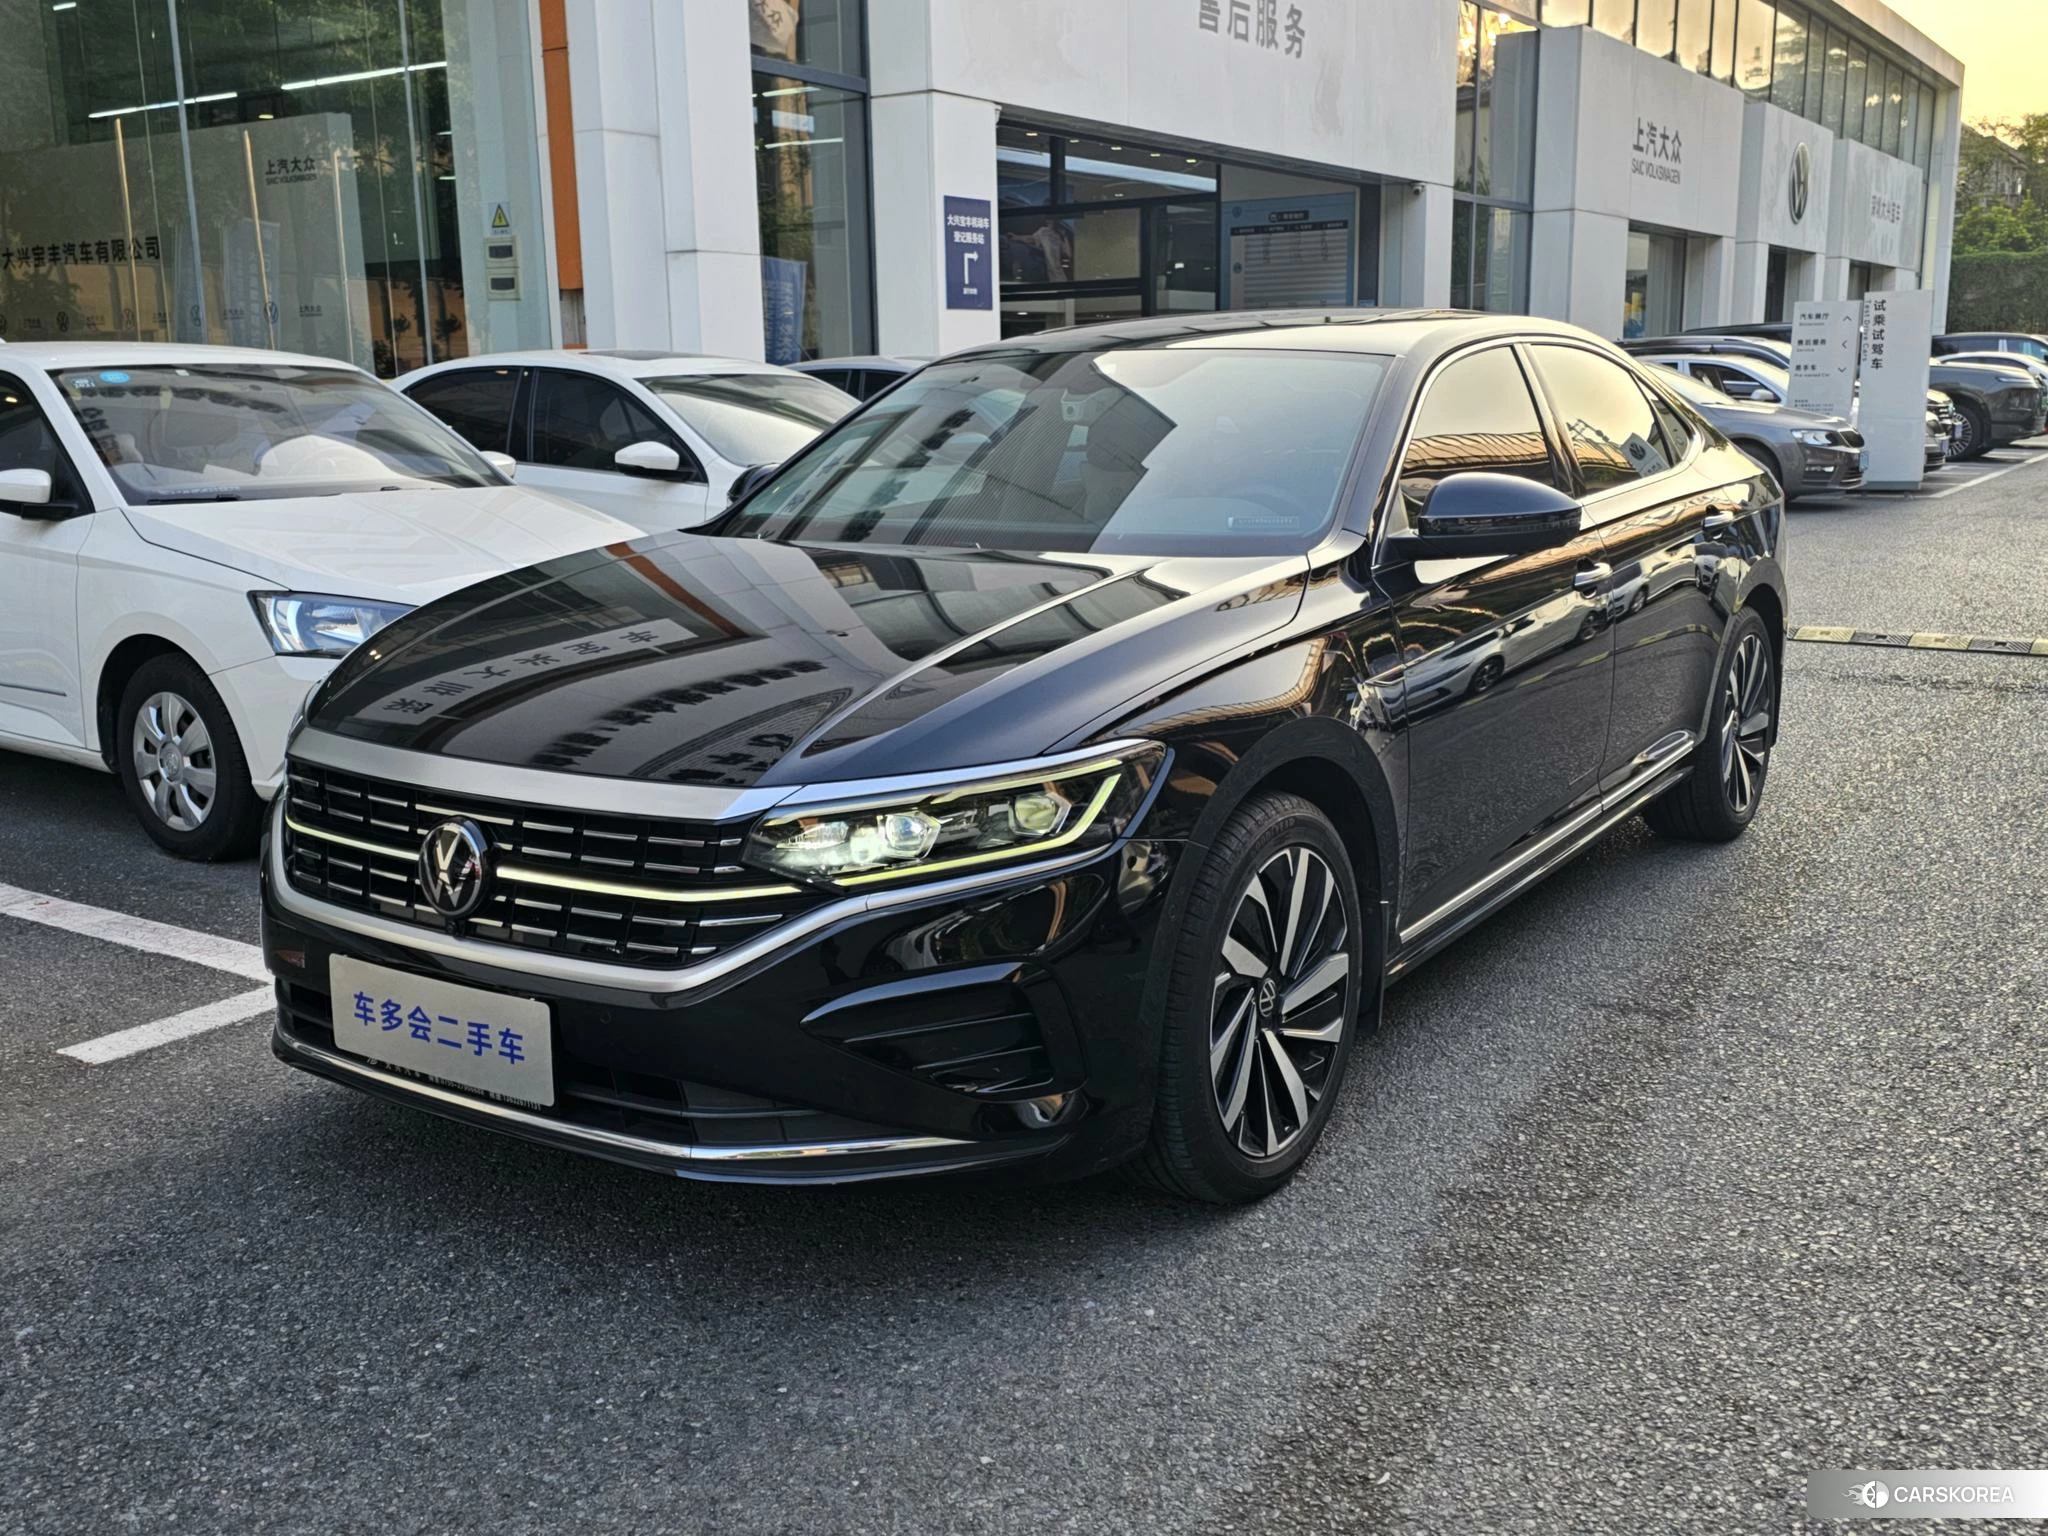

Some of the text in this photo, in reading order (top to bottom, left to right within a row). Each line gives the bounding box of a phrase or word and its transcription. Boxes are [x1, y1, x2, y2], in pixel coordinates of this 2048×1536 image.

[1199, 0, 1305, 59] 售后服务
[265, 155, 317, 175] 上汽大众
[1632, 116, 1682, 164] 上汽大众
[2, 235, 161, 270] 大兴宝丰汽车有限公司
[1871, 299, 1887, 370] 试乘试驾车
[353, 990, 526, 1065] 车多会二手车
